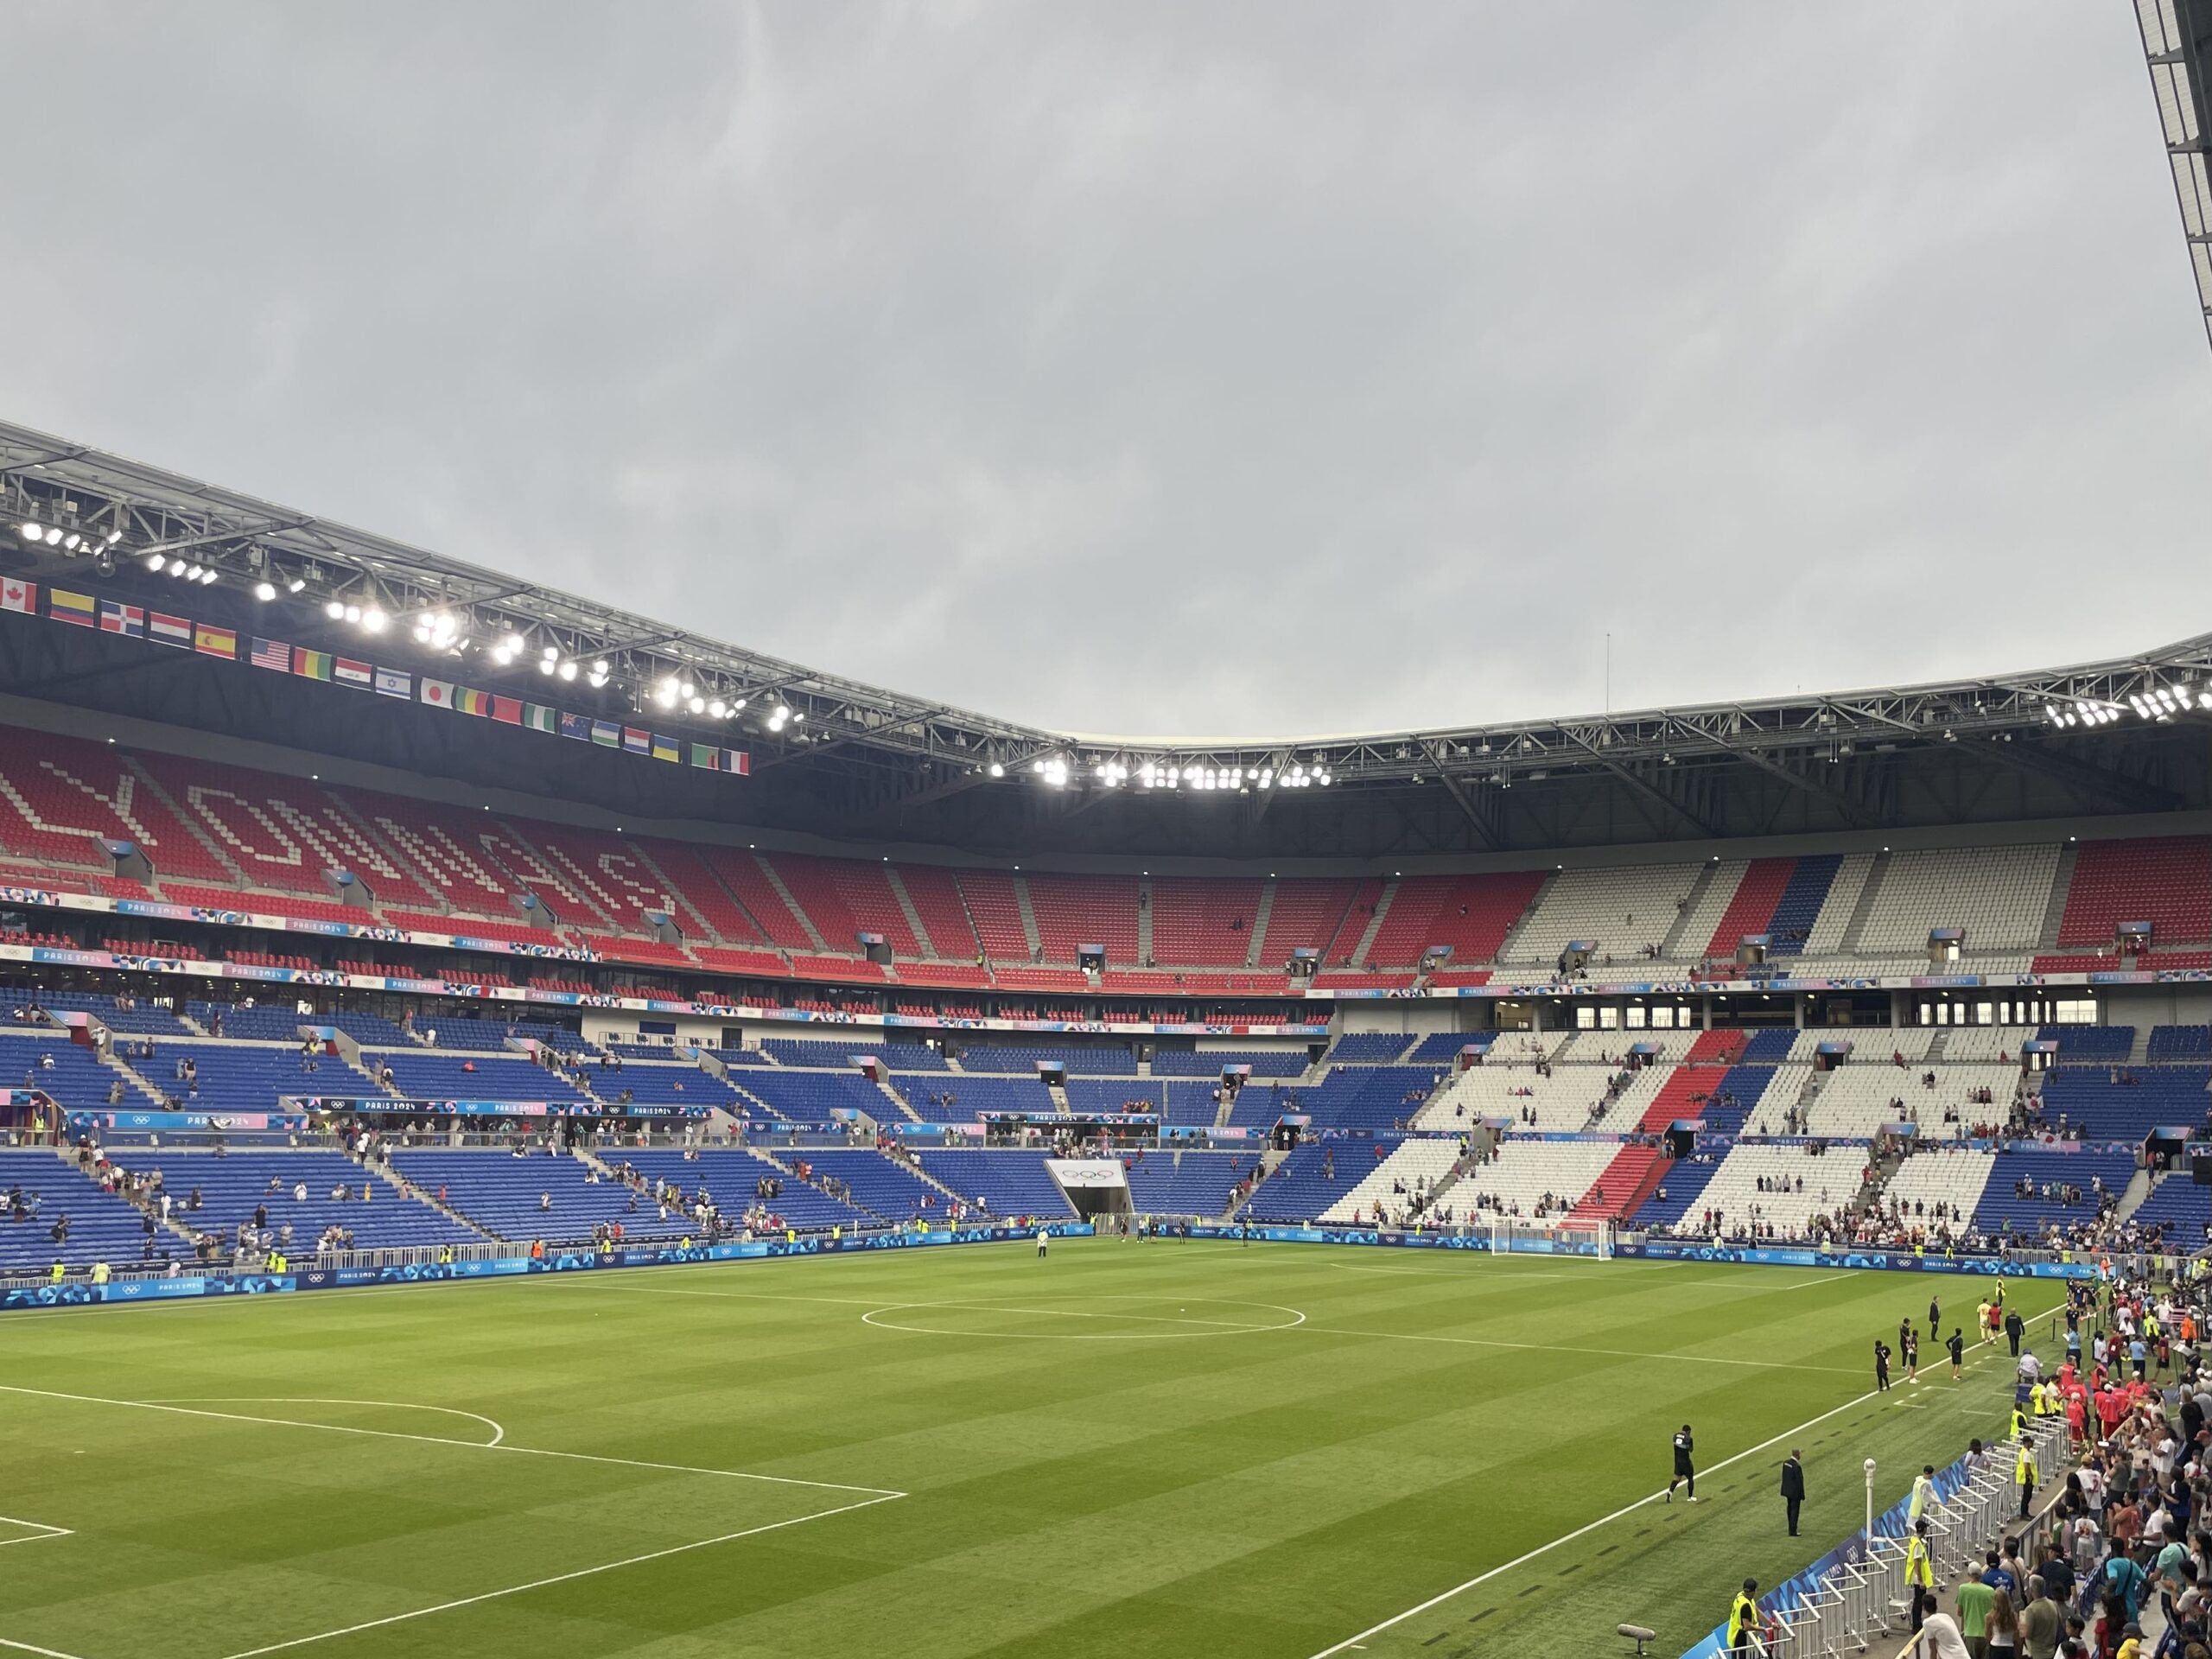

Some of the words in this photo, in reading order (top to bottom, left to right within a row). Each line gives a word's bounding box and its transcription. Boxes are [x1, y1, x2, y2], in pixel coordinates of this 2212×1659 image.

[127, 904, 154, 913] PARIS
[158, 906, 181, 916] 2024
[293, 922, 317, 931] PARIS
[320, 924, 340, 932] 2024
[43, 951, 73, 962] PARIS
[75, 954, 102, 963] 2024
[232, 967, 257, 976] PARIS
[258, 969, 282, 978] 2024
[416, 982, 436, 991] 2024
